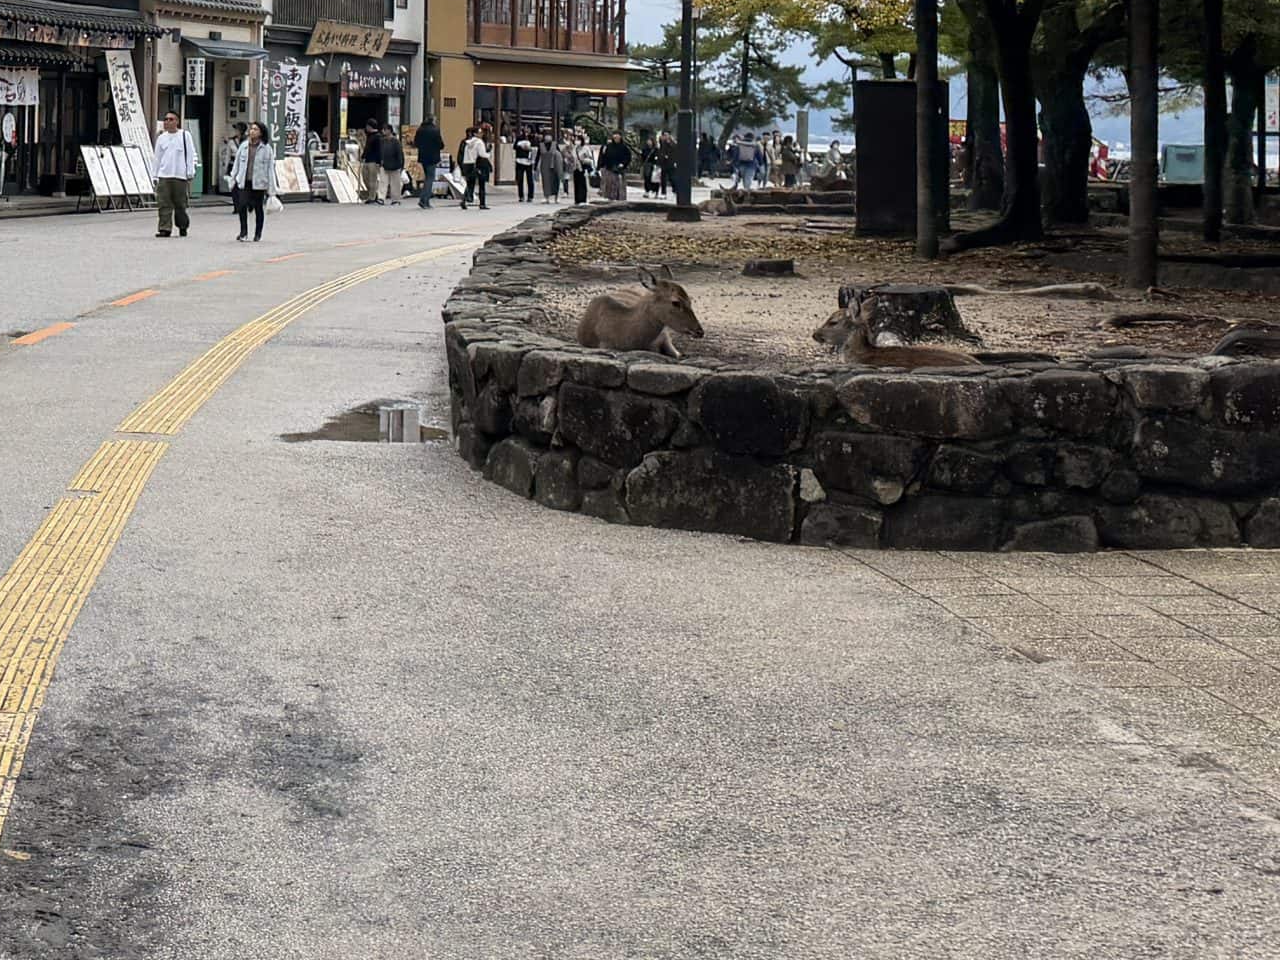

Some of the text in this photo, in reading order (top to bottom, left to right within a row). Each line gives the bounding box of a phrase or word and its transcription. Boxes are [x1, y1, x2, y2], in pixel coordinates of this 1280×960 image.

[271, 92, 281, 159] コーヒー
[285, 68, 302, 128] あなご飯
